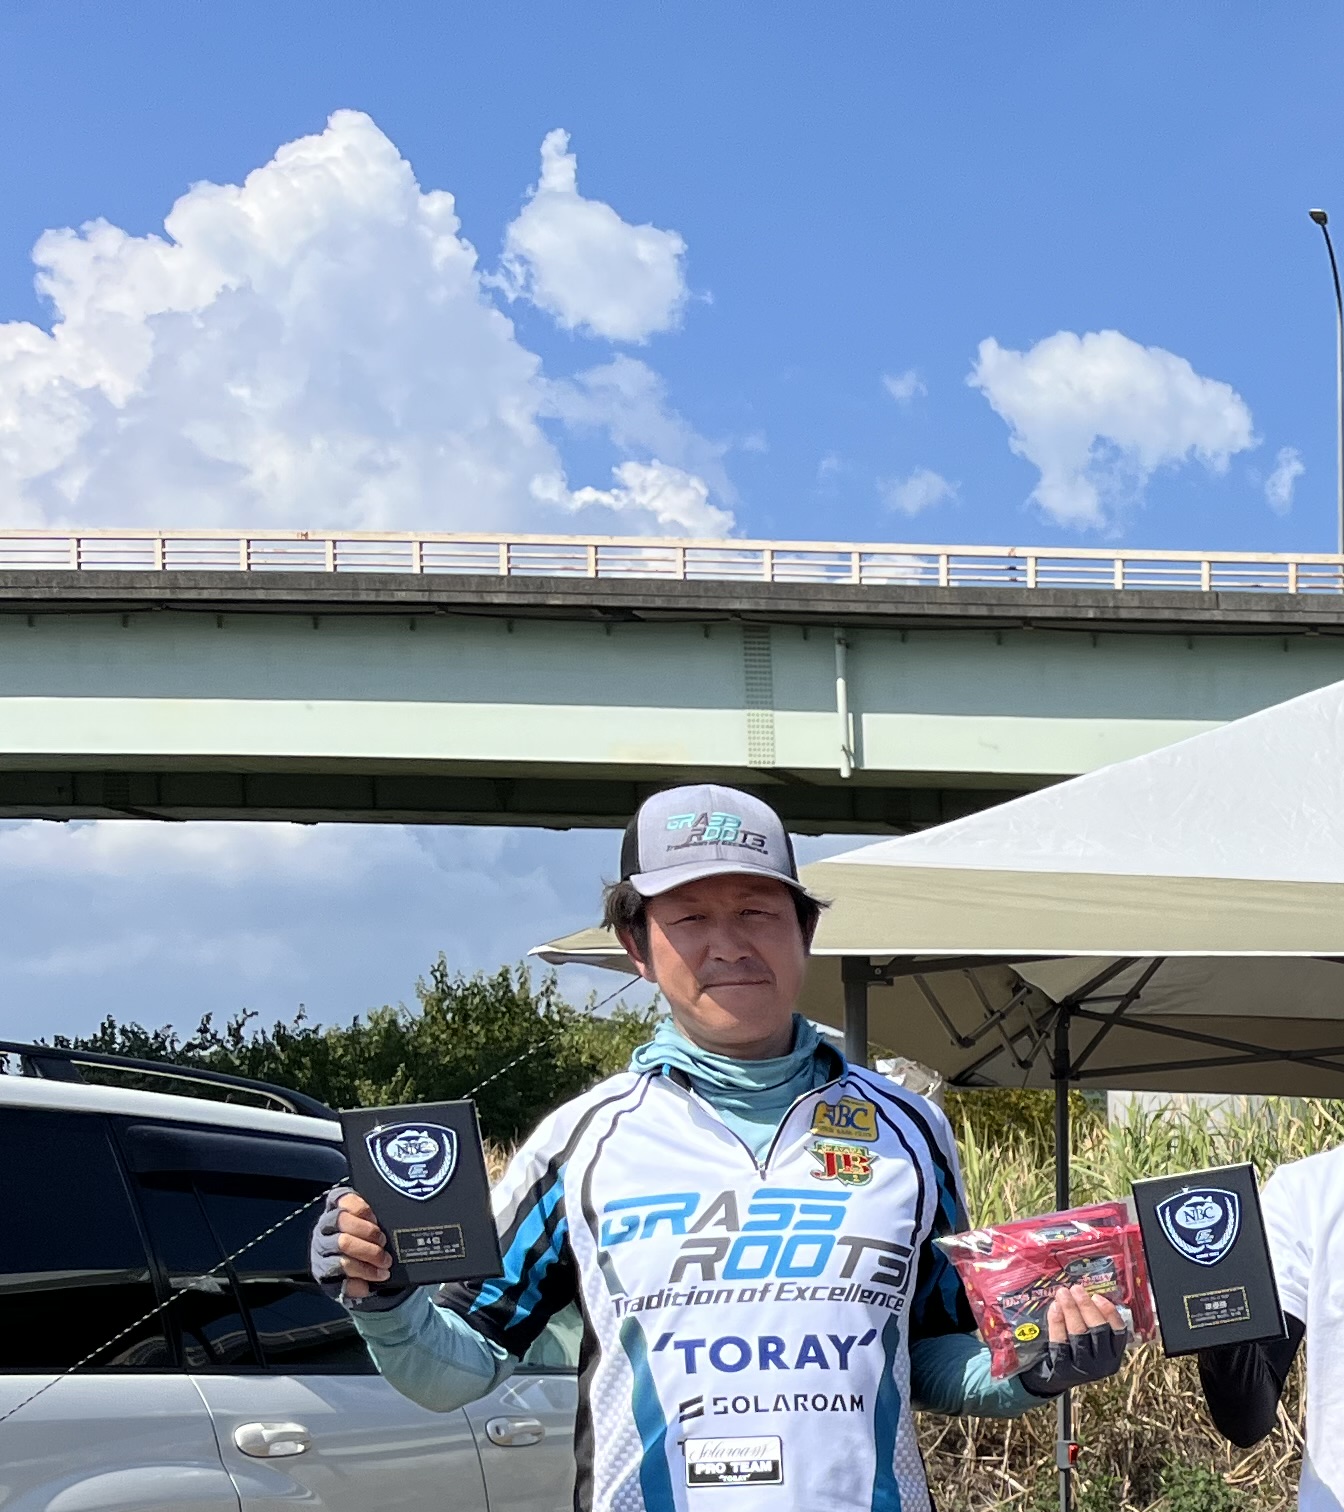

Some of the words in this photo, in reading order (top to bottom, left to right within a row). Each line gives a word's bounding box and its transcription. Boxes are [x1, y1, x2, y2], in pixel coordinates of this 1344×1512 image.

[600, 1188, 852, 1247] GRASS
[1183, 1205, 1216, 1223] NBC
[668, 1235, 914, 1295] ROOTS
[613, 1286, 735, 1318] Tradition
[737, 1283, 774, 1305] of
[775, 1281, 906, 1312] Excellence
[713, 1394, 865, 1417] SOLAROAM
[695, 1463, 727, 1474] PRO
[730, 1461, 772, 1474] TEAM
